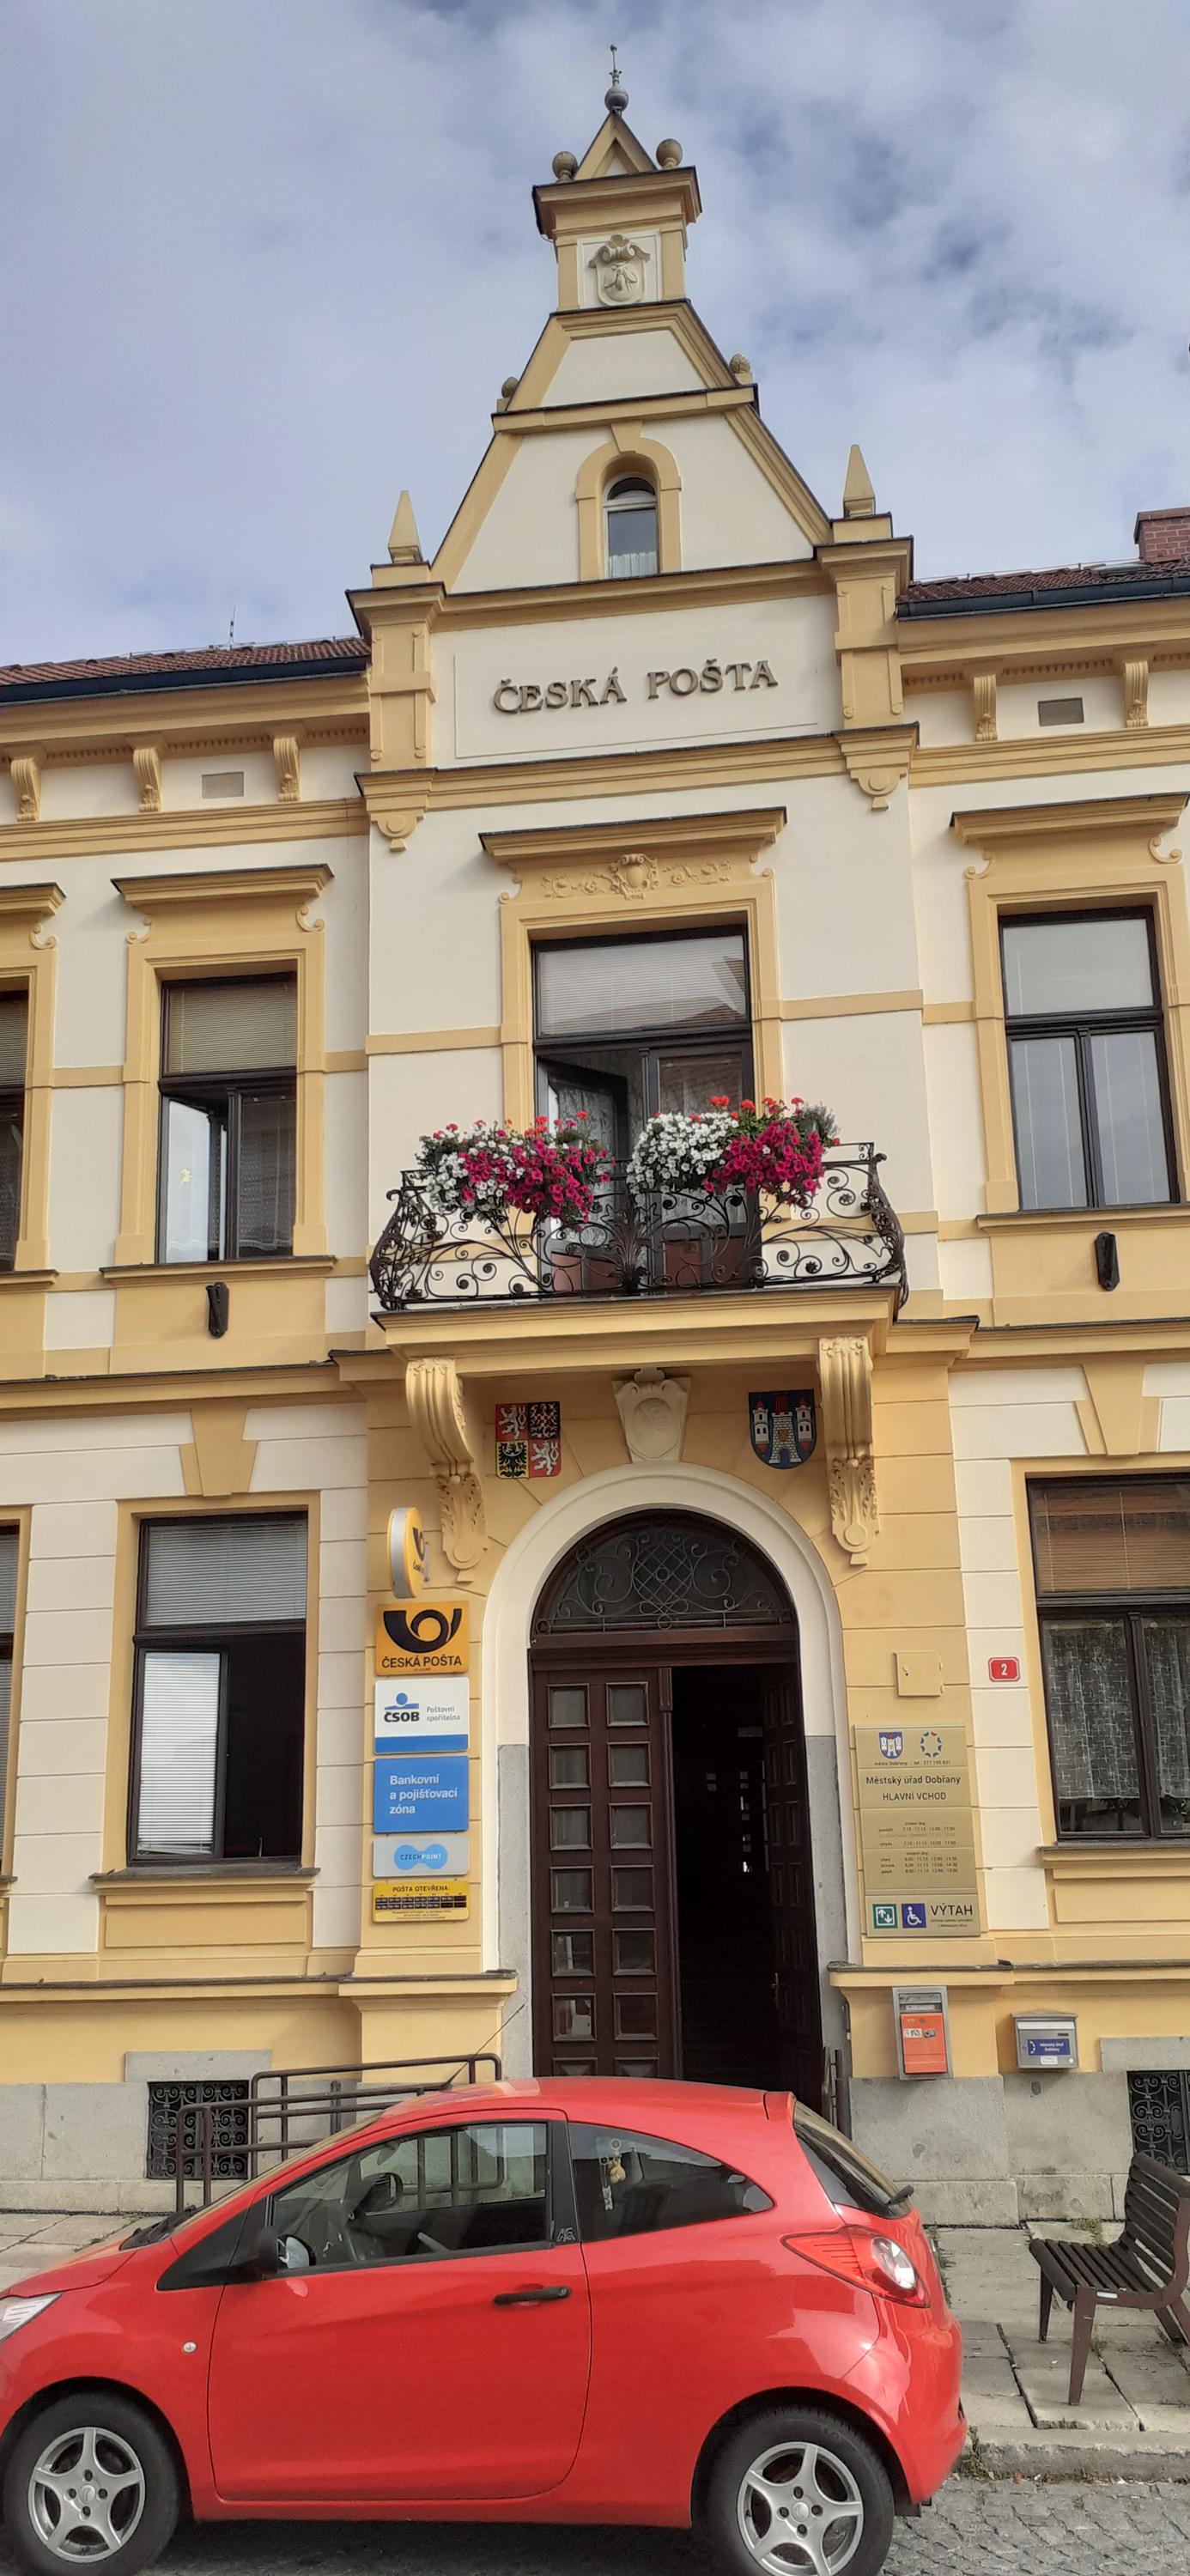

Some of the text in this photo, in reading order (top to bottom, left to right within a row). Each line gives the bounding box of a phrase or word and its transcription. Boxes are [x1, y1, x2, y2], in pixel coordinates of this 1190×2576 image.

[494, 659, 779, 714] ČESKÁ POŠTA
[382, 1654, 462, 1668] ČESKÁ POŠTA
[1000, 1662, 1008, 1676] 2
[384, 1711, 420, 1722] ČSOB
[427, 1714, 460, 1722] spořitelna
[390, 1774, 440, 1785] Bankovní
[865, 1775, 961, 1786] Městský úřad Dobřany
[390, 1787, 458, 1801] a pojišťovací
[883, 1791, 947, 1801] HLAVNÍ VCHOD
[390, 1804, 416, 1814] zóna
[931, 1903, 973, 1916] VÝTAH
